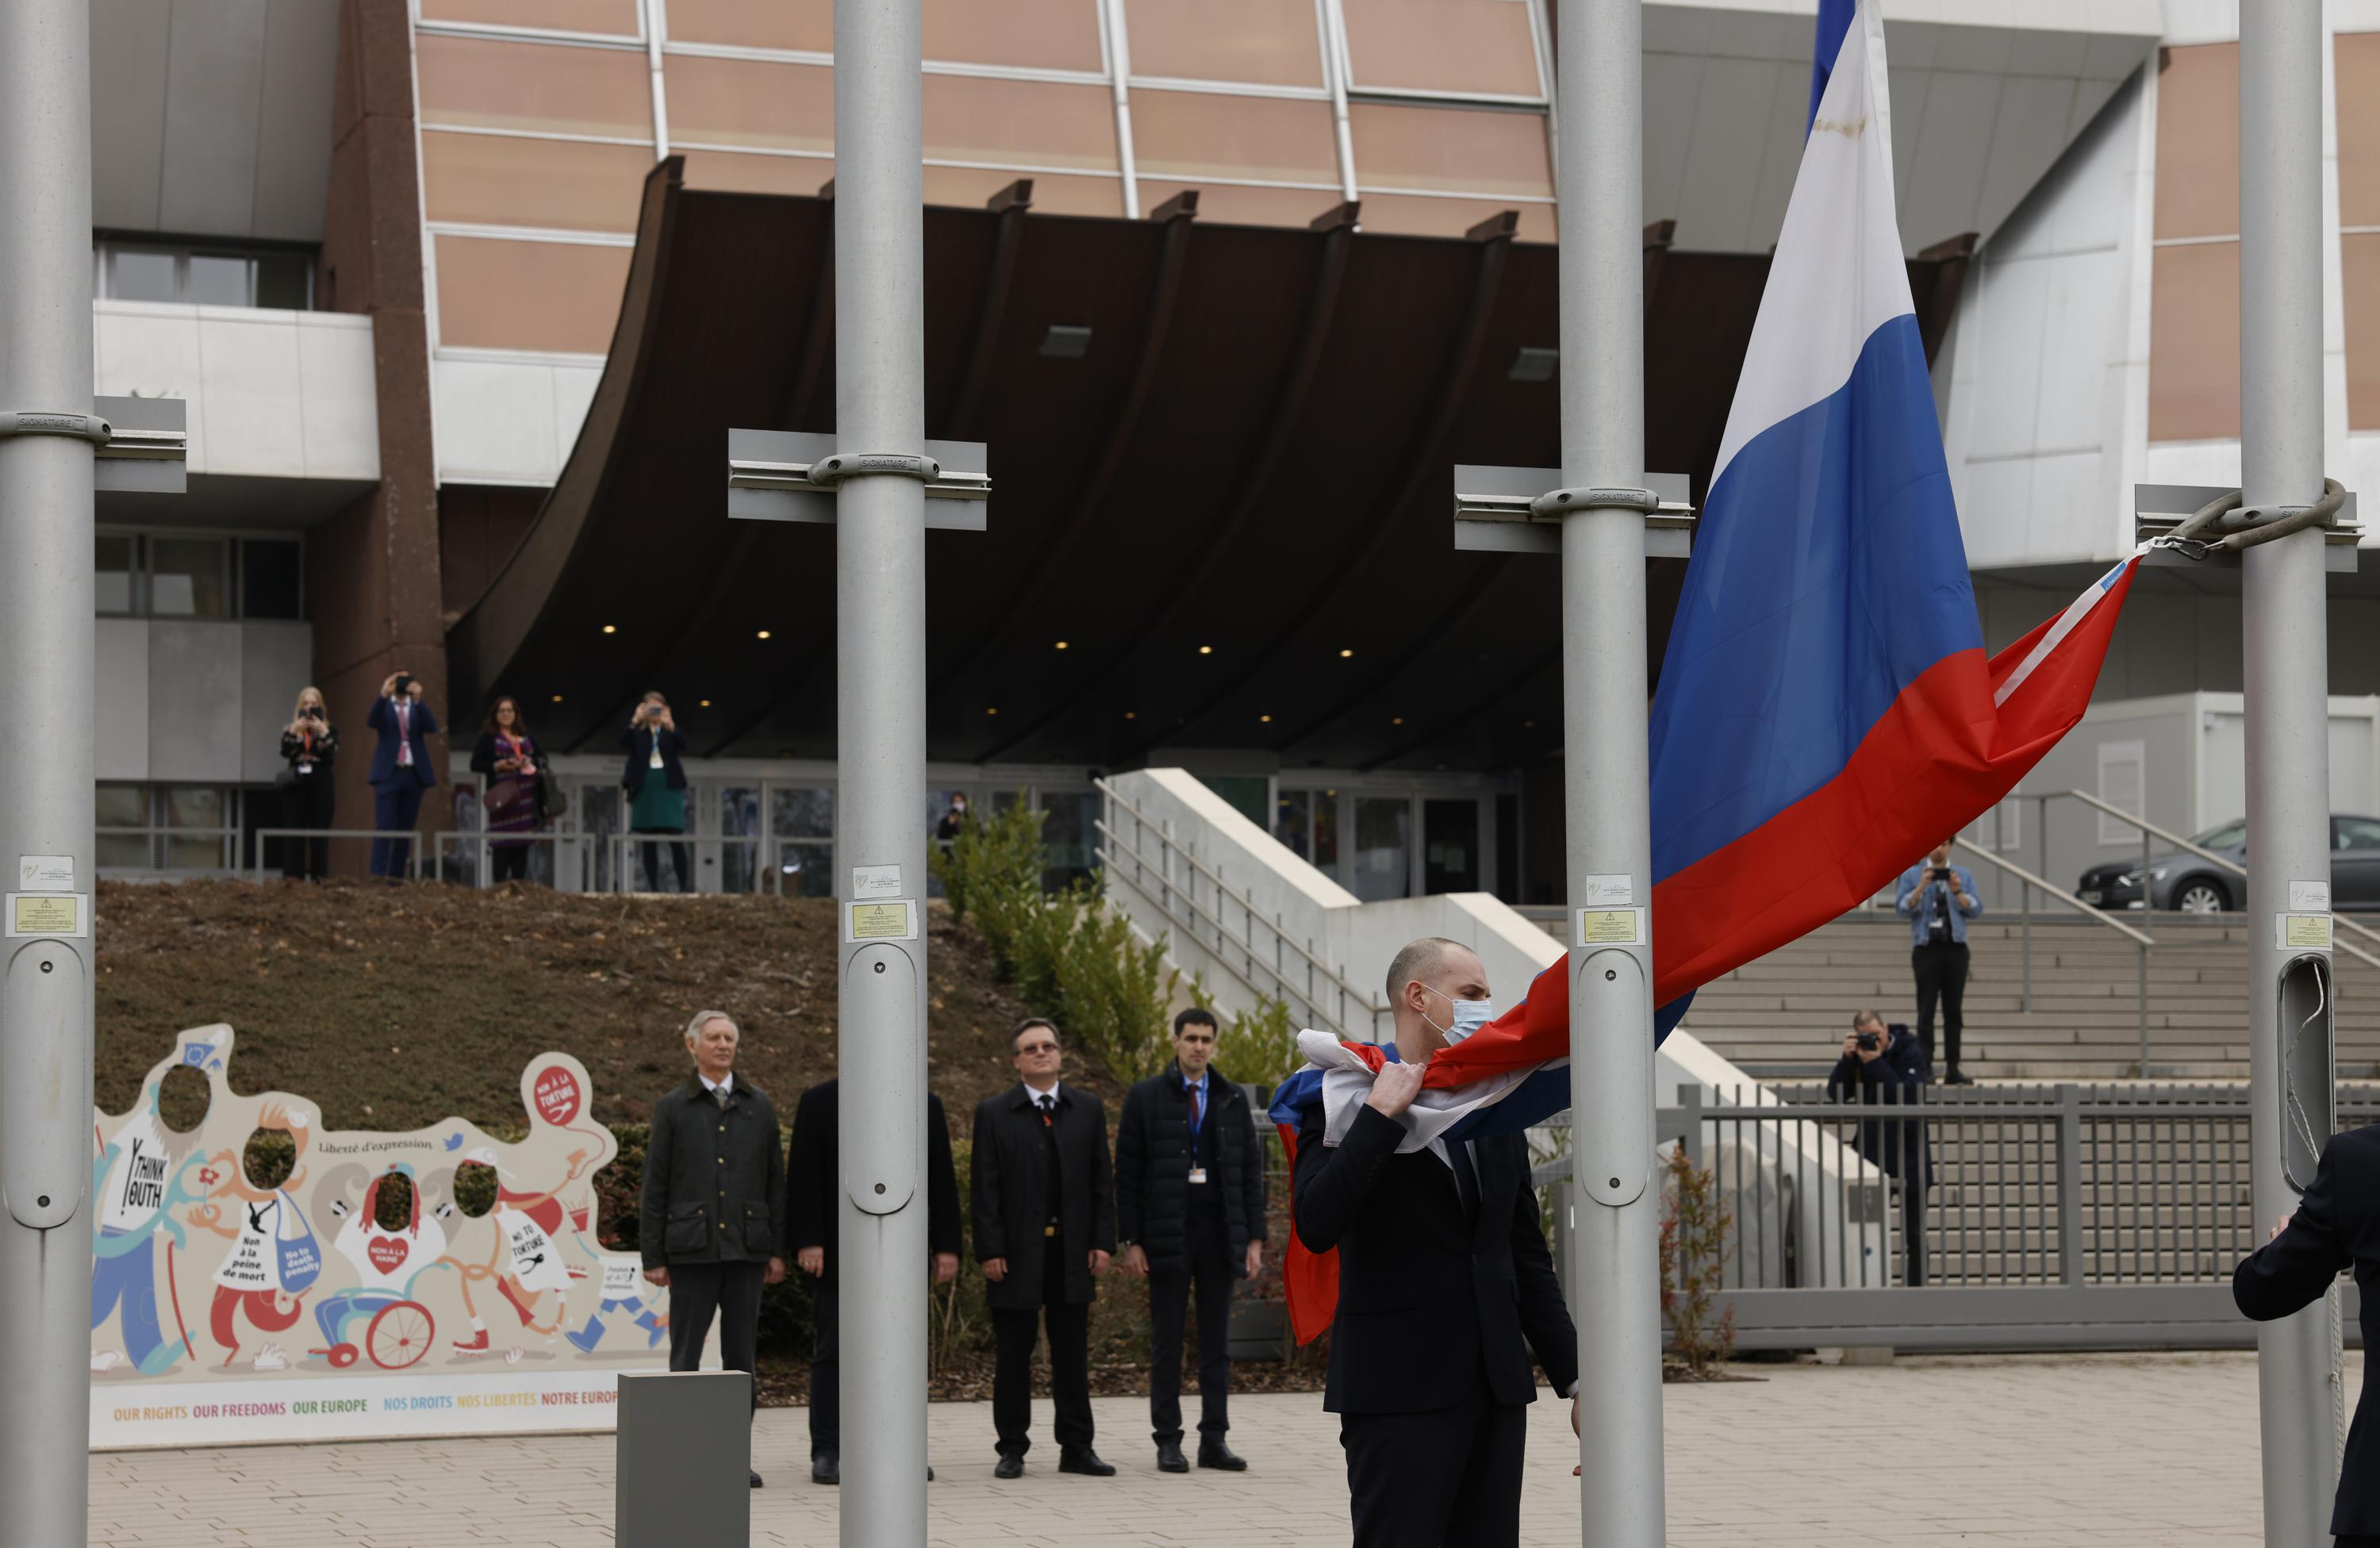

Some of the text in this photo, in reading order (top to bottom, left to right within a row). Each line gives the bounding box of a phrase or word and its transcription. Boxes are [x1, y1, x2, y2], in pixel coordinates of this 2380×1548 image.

[19, 418, 71, 428] SIGNATURE
[537, 1082, 551, 1094] NON
[559, 1073, 570, 1085] LA
[539, 1085, 575, 1108] TORTURE
[319, 1139, 432, 1153] Liberté d'expression
[134, 1155, 167, 1181] THINK
[512, 1223, 533, 1243] NO TO
[243, 1237, 260, 1246] Non
[512, 1234, 545, 1256] TORTURE
[248, 1248, 256, 1257] la
[285, 1247, 309, 1260] No to
[232, 1259, 261, 1269] peine
[287, 1254, 314, 1269] death
[223, 1268, 266, 1281] de mort
[286, 1262, 319, 1279] penalty
[114, 1390, 618, 1421] OUR RIGHTS OUR FREEDOMS OUR EUROPE NOS DROITS NOS LIBERTÉS NOTRE EUROP
